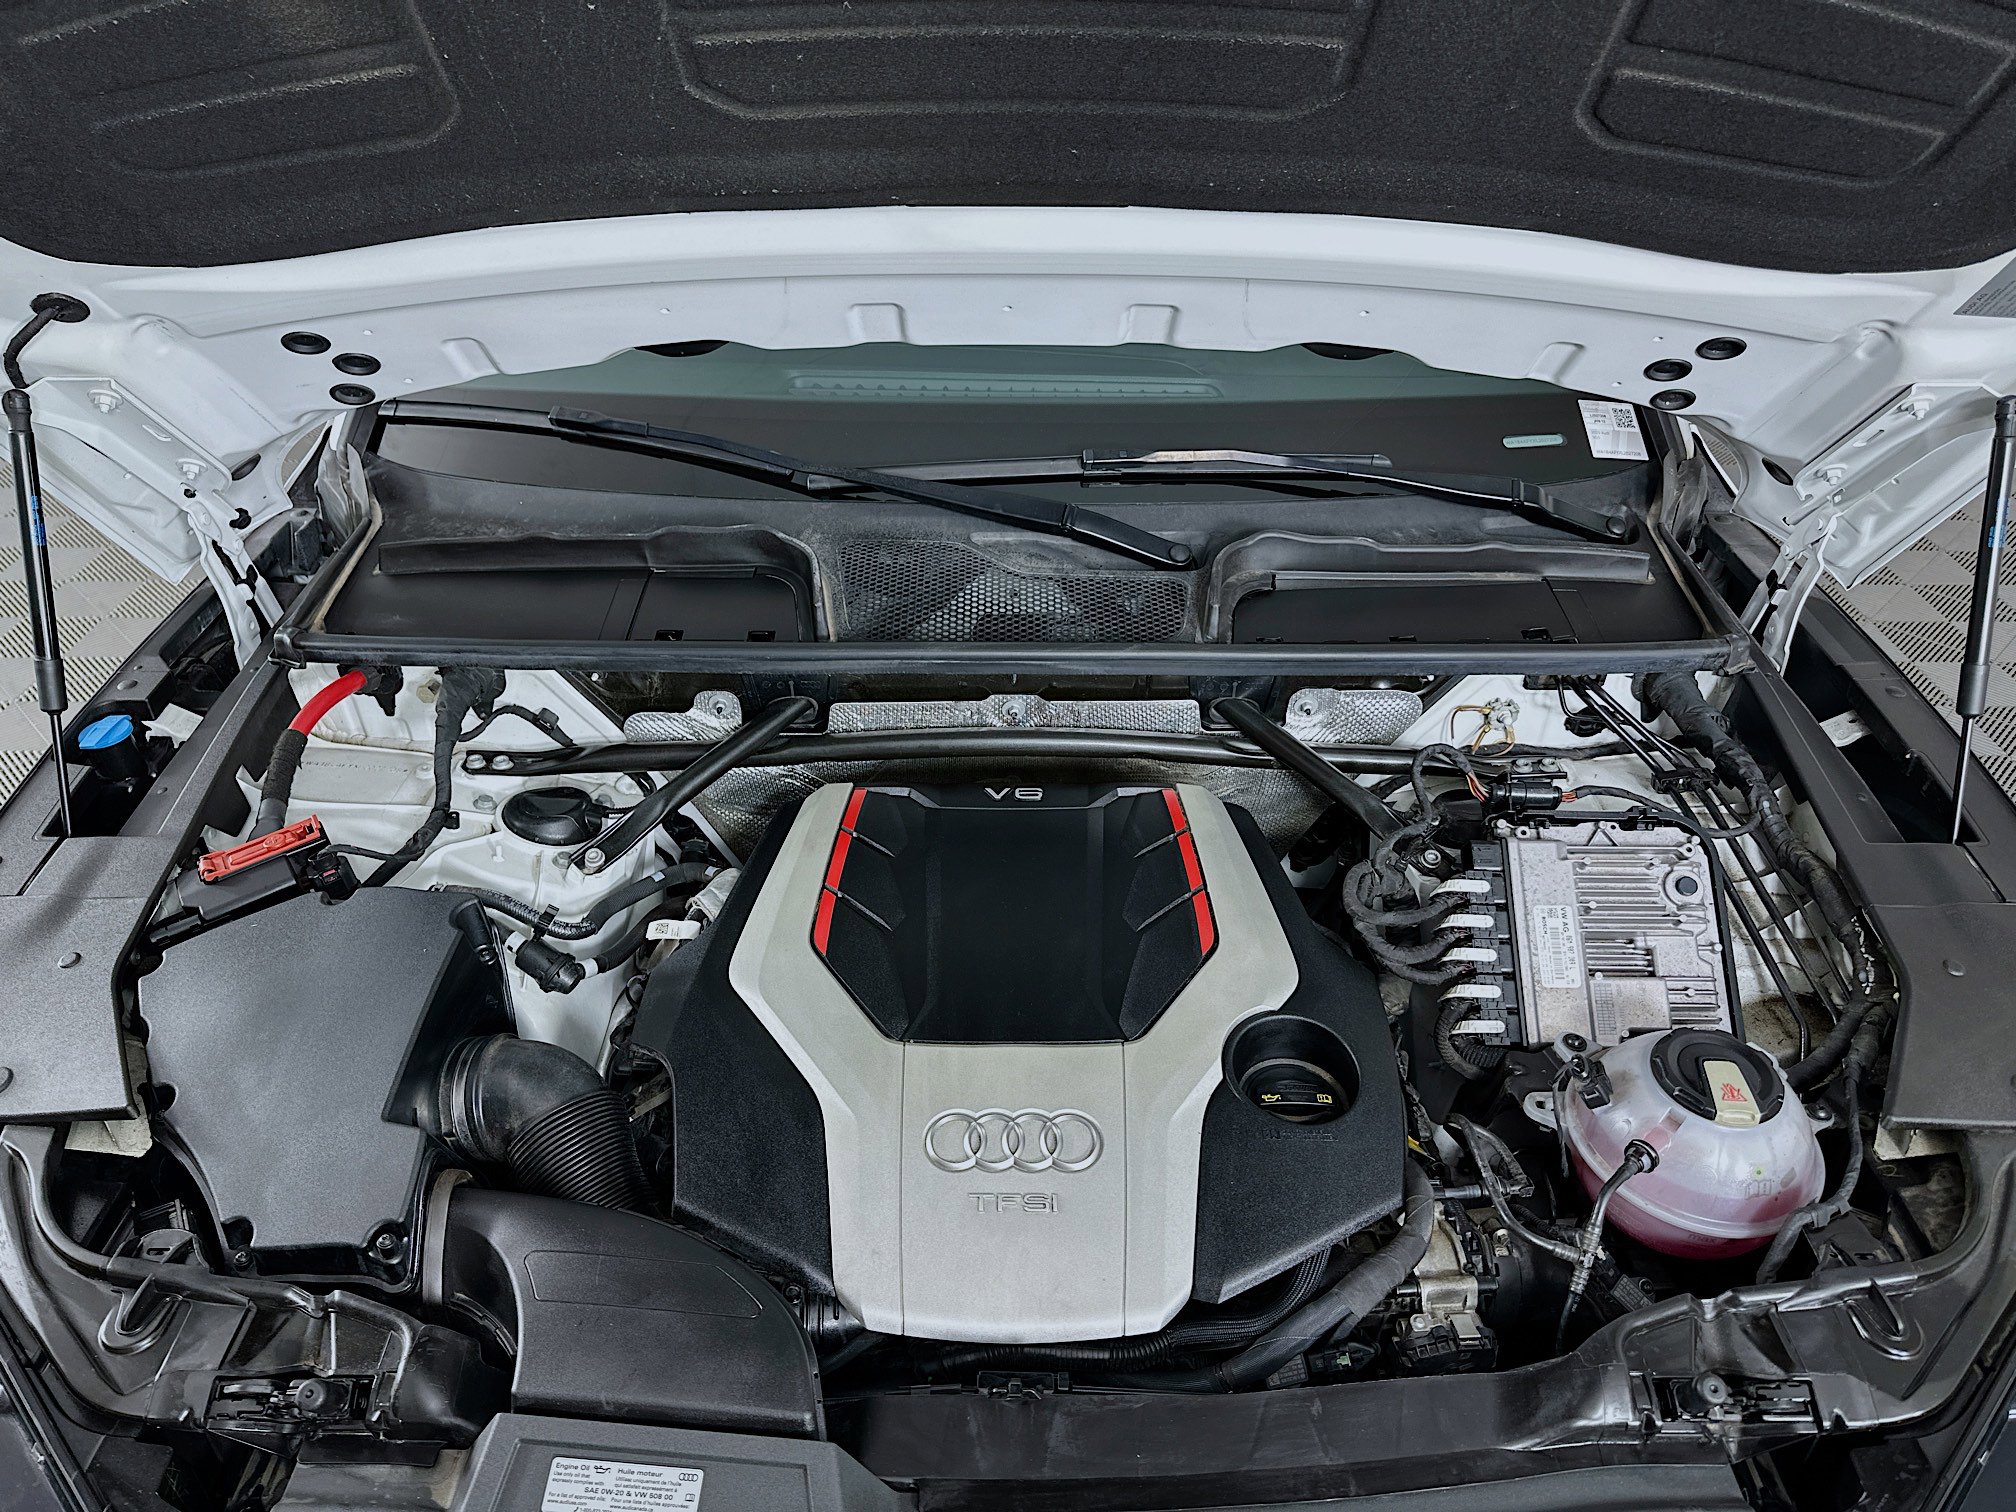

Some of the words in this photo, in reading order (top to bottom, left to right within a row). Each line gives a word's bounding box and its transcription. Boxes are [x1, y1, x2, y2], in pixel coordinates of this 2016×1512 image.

[984, 788, 1043, 801] V6
[1560, 907, 1568, 920] VW
[1562, 921, 1570, 933] AG
[968, 1192, 1060, 1213] TFSI
[555, 1462, 579, 1471] Engine
[636, 1470, 663, 1478] moteur
[584, 1486, 599, 1494] SAE
[600, 1488, 625, 1496] 0W-20
